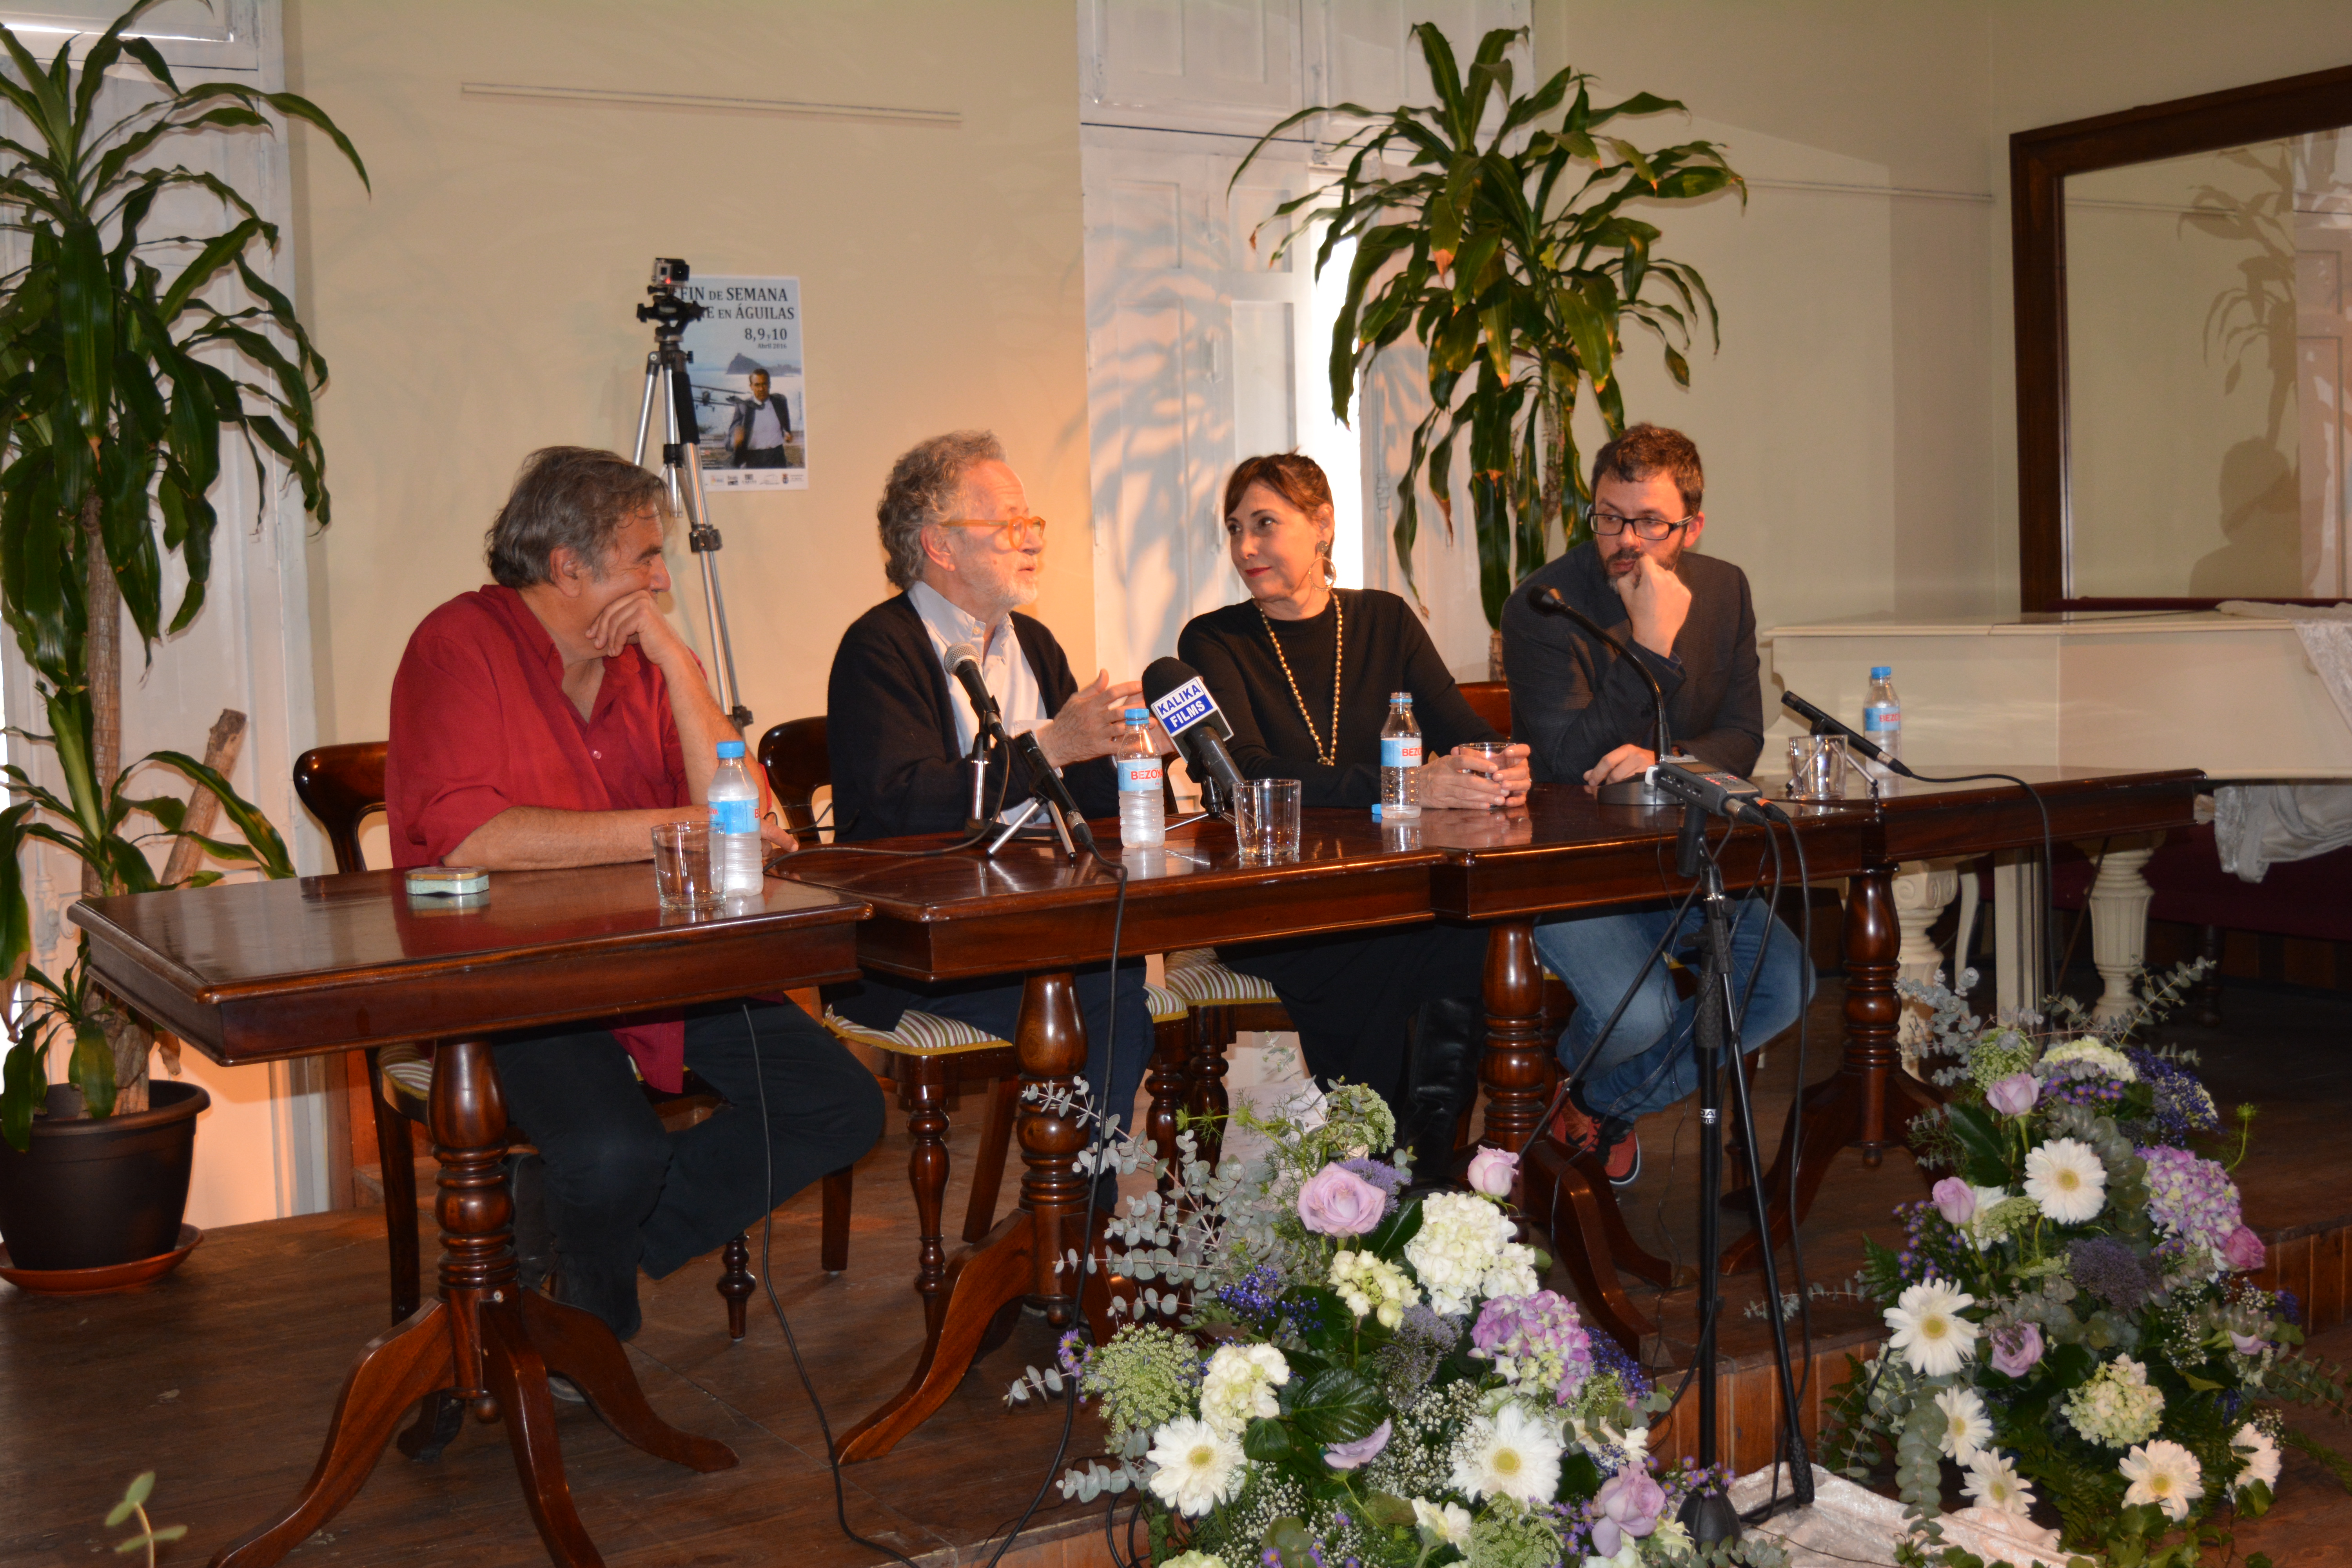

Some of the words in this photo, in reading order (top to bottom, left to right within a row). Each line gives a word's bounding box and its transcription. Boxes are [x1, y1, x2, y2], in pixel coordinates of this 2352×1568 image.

[681, 287, 704, 300] FIN
[709, 290, 723, 301] DE
[726, 287, 788, 301] SEMANA
[718, 309, 731, 319] EN
[735, 303, 795, 320] ÁGUILAS
[1157, 684, 1201, 715] KALIKA
[1169, 701, 1205, 728] FILMS
[1131, 769, 1163, 780] BEZOYA
